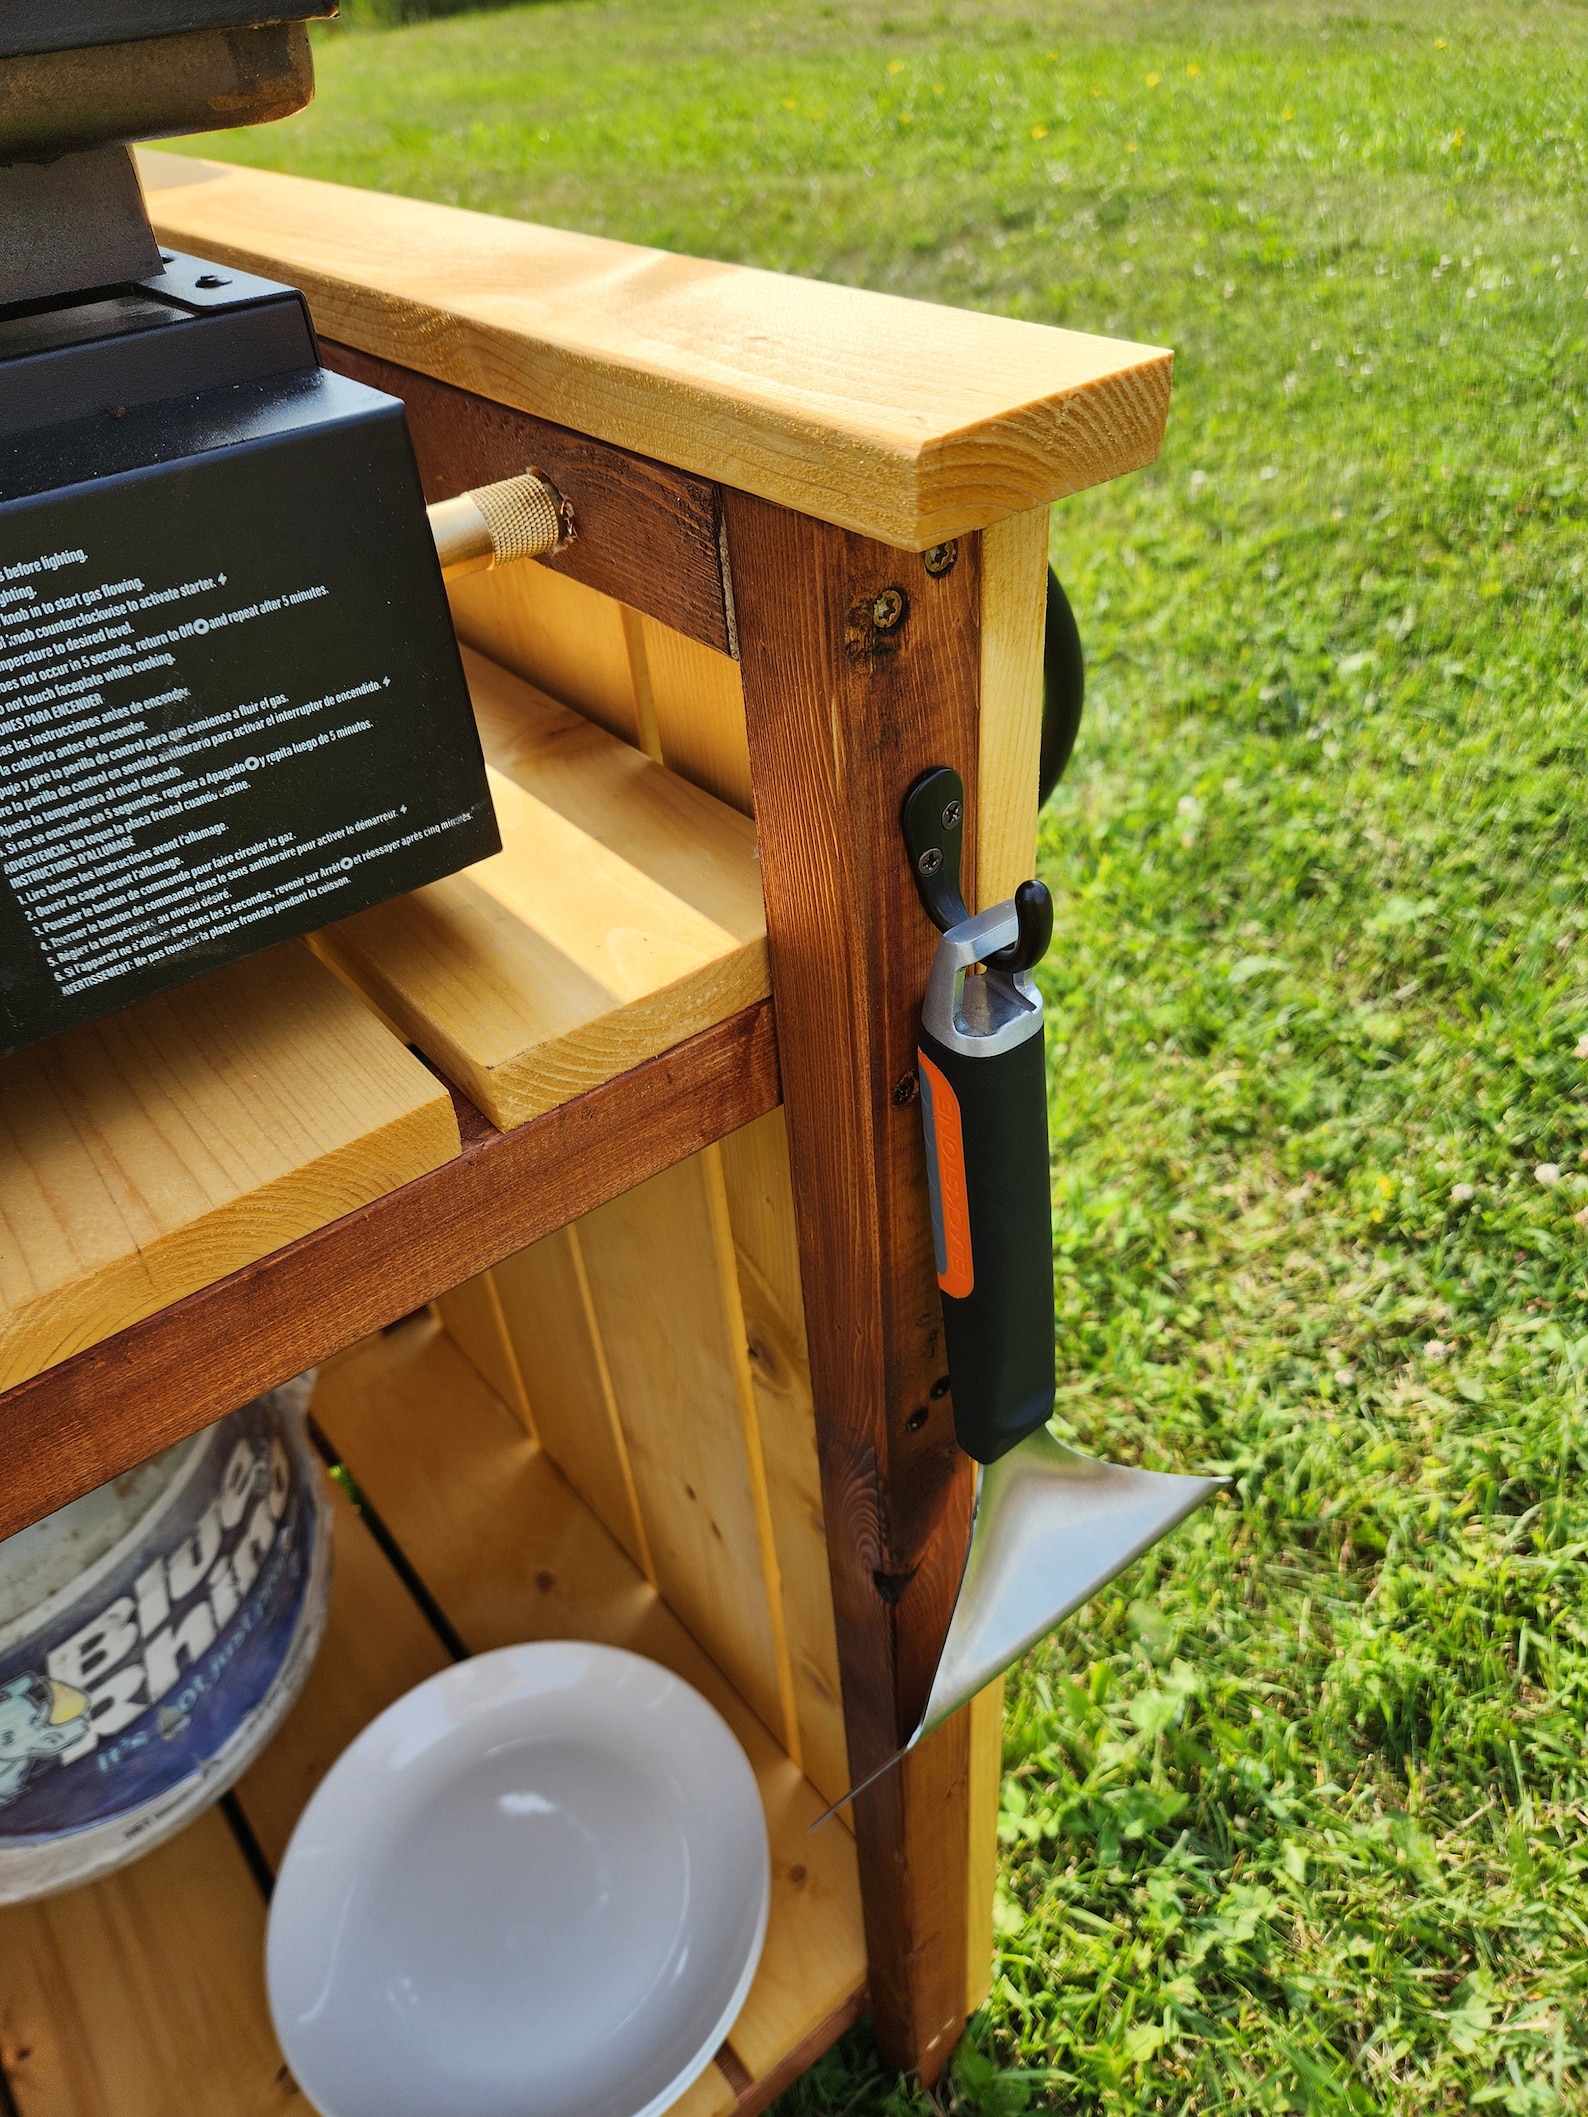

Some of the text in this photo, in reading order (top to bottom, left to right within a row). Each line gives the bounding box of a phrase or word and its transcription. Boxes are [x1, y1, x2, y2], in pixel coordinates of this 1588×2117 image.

[3, 561, 42, 580] before
[40, 549, 88, 570] lighting.
[1, 578, 145, 626] knob in to start gas flowing.
[19, 585, 329, 686] not occur in seconds, return to Off and repeat after minutes.
[35, 578, 217, 638] counterclockwise to activate starter.
[52, 621, 135, 655] to desired level.
[5, 697, 25, 712] not
[23, 687, 56, 706] touch
[54, 674, 104, 696] faceplate
[102, 664, 133, 681] while
[132, 653, 176, 673] cooking.
[23, 709, 53, 727] PARA
[51, 693, 103, 718] ENCENDER
[11, 680, 382, 812] la perilla de control en sentido para activar el interruptor de encendido.
[11, 721, 148, 772] cubierta antes de encender.
[12, 701, 144, 751] las instrucciones antes de
[29, 694, 289, 789] gire la perilla de control para que comience fluir gas.
[0, 766, 184, 838] Ajuste la temperatura al nivel deseado.
[5, 841, 18, 854] Si
[17, 838, 32, 850] no
[31, 834, 46, 845] se
[45, 817, 91, 840] enciende
[91, 812, 105, 824] en
[112, 793, 163, 816] segundos,
[161, 779, 199, 799] regrese
[206, 762, 246, 784] Apagado
[265, 747, 293, 765] repita
[291, 738, 318, 753] luego
[317, 733, 329, 745] de
[336, 720, 373, 738] minutos.
[3, 843, 71, 874] ADVERTENCIA:
[69, 839, 86, 850] No
[84, 828, 114, 845] toque
[112, 824, 125, 835] la
[124, 815, 152, 833] placa
[150, 801, 184, 821] frontal
[9, 835, 136, 889] INSTRUCTIONS D'ALLUMAGE
[25, 822, 229, 902] Lire toutes les instructions avant l'allumage.
[35, 856, 184, 917] Ouvrir le capot avant l'allumage.
[42, 832, 296, 932] Pousser le bouton de commande pour faire circuler le gaz.
[73, 948, 119, 973] l'appareil
[118, 945, 132, 956] ne
[187, 915, 210, 929] dans
[209, 909, 224, 920] les
[231, 890, 275, 912] secondes,
[274, 877, 304, 895] revenir
[305, 872, 319, 883] sur
[353, 854, 362, 864] et
[361, 840, 400, 861] réessayer
[401, 831, 423, 846] après
[423, 825, 441, 837] cinq
[86, 923, 99, 933] le
[96, 911, 132, 929] bouton
[131, 905, 145, 916] de
[144, 886, 195, 911] commande
[195, 878, 218, 892] dans
[216, 874, 227, 883] le
[226, 866, 249, 880] sens
[248, 848, 296, 872] antihoraire
[296, 840, 316, 856] pour
[316, 829, 345, 846] activer
[345, 825, 354, 835] le
[61, 876, 351, 995] AVERTISSEMENT: Ne pas la plaque frontale pendant la cuisson.
[88, 941, 100, 950] la
[157, 913, 170, 924] au
[169, 901, 201, 919] niveau
[936, 1094, 969, 1278] BLACKSTONE
[47, 1438, 254, 1687] Blue
[60, 1438, 291, 1766] Rhino
